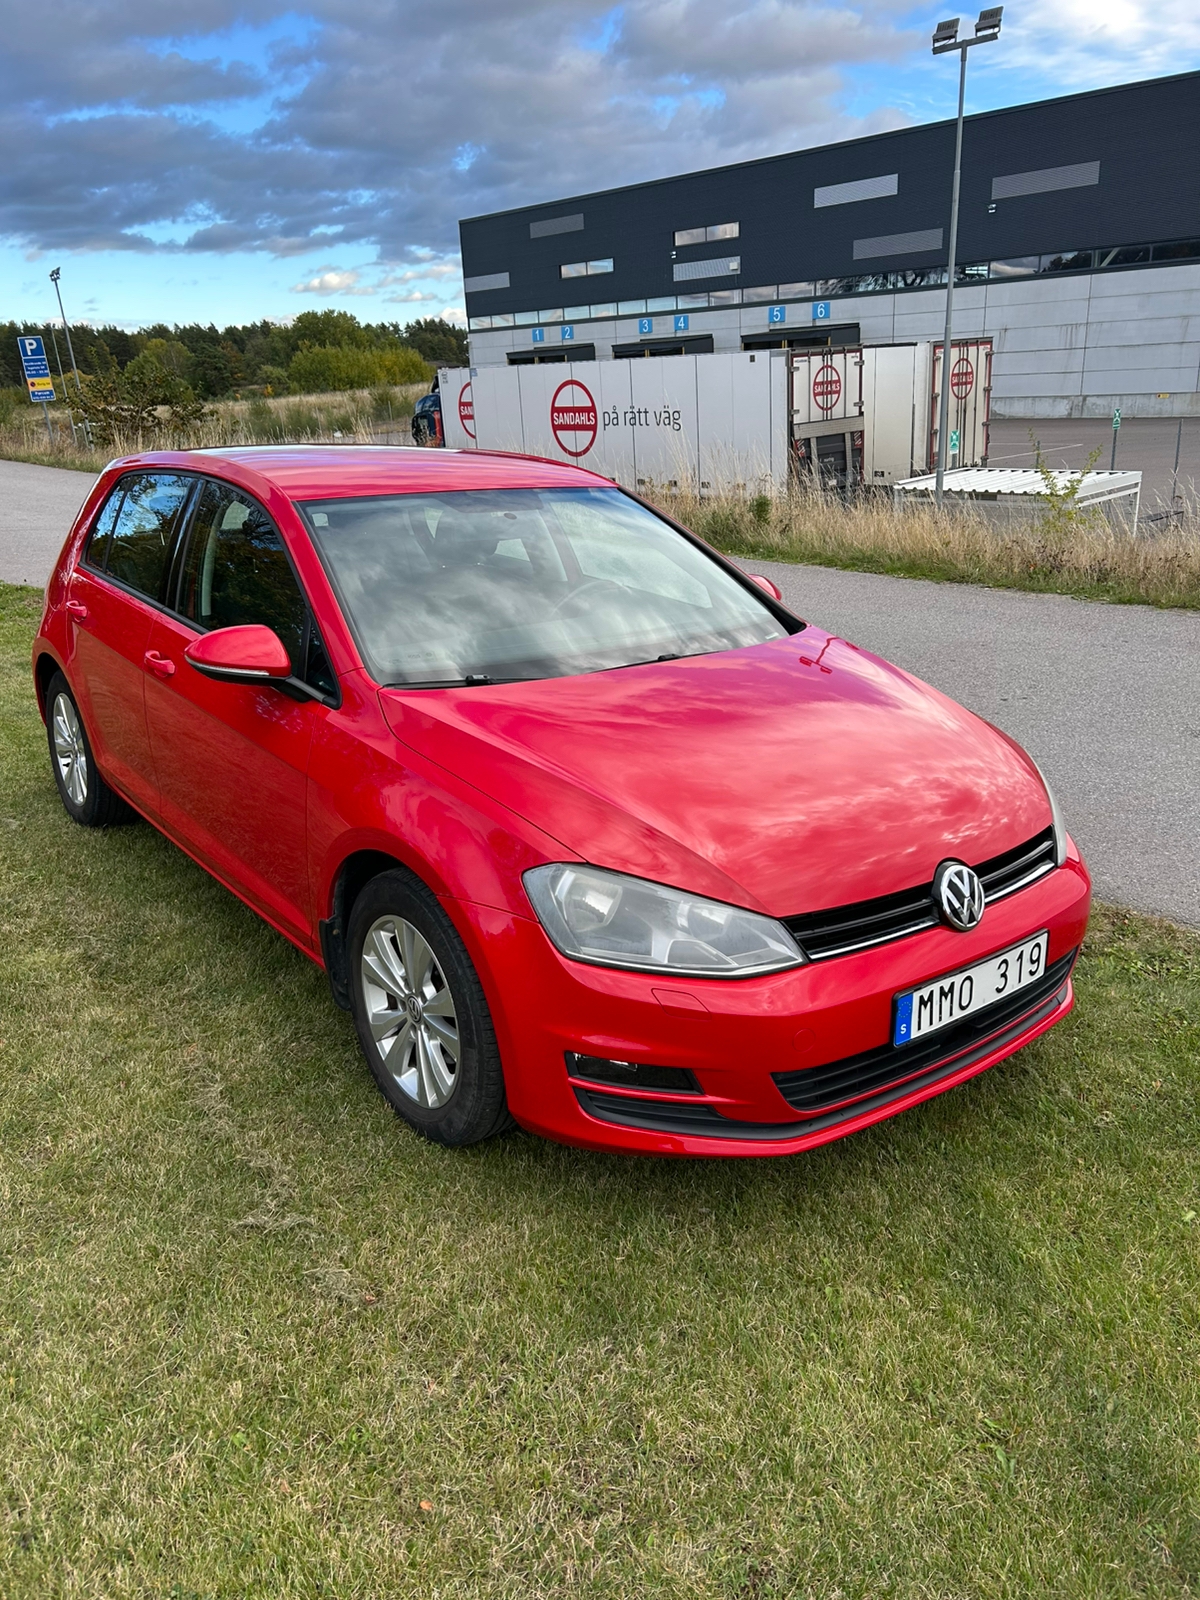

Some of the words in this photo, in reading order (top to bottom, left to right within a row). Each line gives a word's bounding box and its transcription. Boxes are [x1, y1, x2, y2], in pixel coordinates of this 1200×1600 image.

[773, 307, 781, 321] 5
[817, 303, 825, 318] 6
[642, 319, 649, 333] 3
[677, 316, 685, 329] 4
[535, 330, 540, 341] 1
[564, 326, 571, 339] 2
[24, 339, 37, 356] P
[952, 374, 973, 384] SAALS
[814, 382, 840, 393] SANALS
[553, 411, 595, 426] SANDAHLS
[602, 405, 619, 431] på
[624, 406, 649, 427] rätt
[653, 405, 682, 431] väg
[941, 864, 985, 930] VW
[917, 974, 974, 1032] MMO
[995, 941, 1042, 994] 319
[900, 1023, 907, 1035] S
